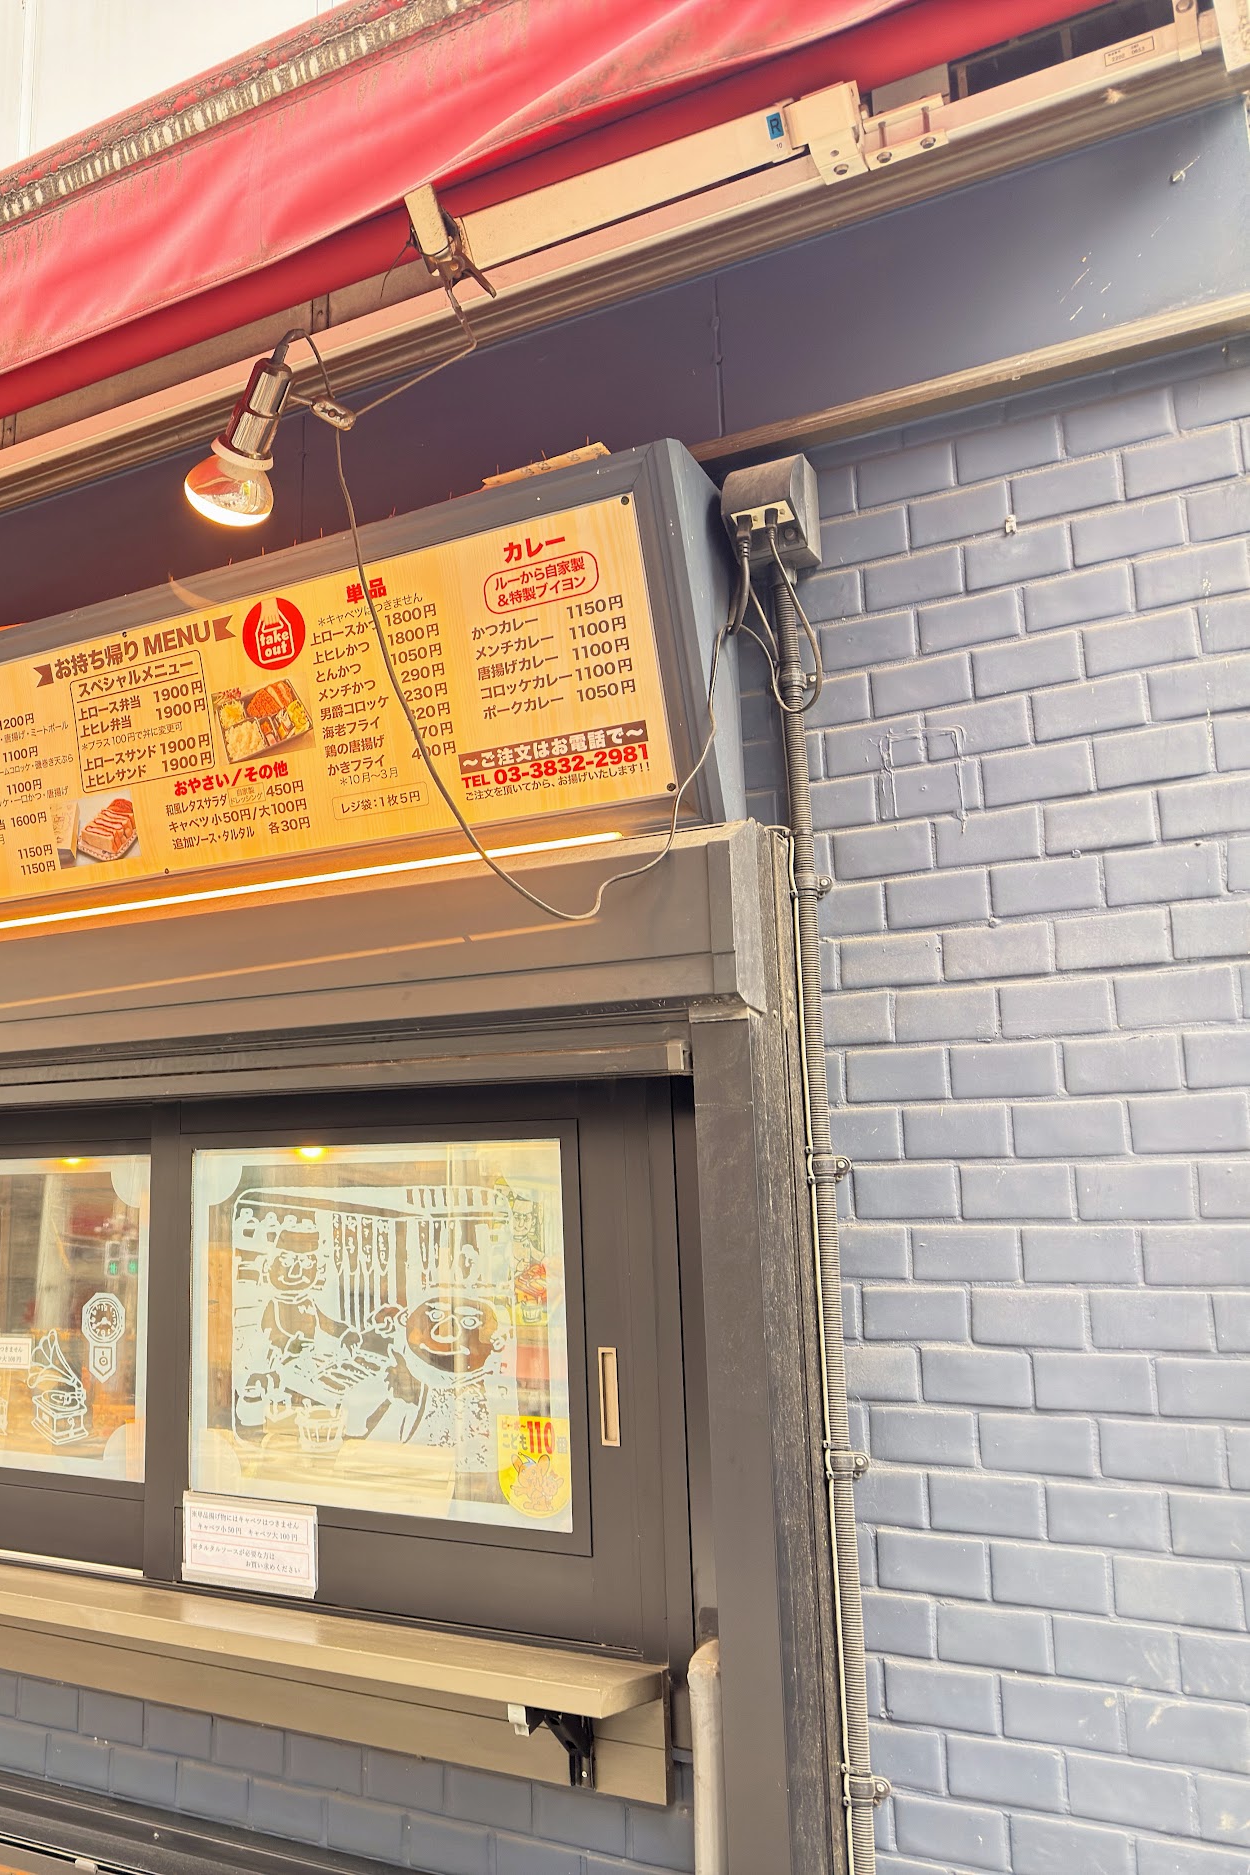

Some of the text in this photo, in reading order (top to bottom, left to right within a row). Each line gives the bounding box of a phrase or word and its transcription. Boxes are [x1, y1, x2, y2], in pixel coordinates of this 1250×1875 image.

[770, 118, 781, 135] R
[504, 536, 565, 564] カレー
[346, 577, 388, 604] 単品
[495, 556, 585, 591] ルーから自家製
[385, 603, 437, 627] 1800円
[471, 594, 623, 641] かつカレー 1150円
[54, 620, 211, 680] お持ち帰り MENU
[259, 629, 290, 648] take
[264, 642, 288, 658] out
[312, 623, 440, 665] 上ヒレかつ 1800円
[475, 615, 627, 661] メンチカレー 1100円
[315, 642, 442, 683] とんかつ 1050円
[478, 637, 630, 681] 唐揚げカレー 1100円
[78, 660, 194, 698] スペシャルメニュー
[318, 662, 445, 702] メンチかつ 290円
[480, 658, 633, 700] コロッケカレー 1100円
[78, 680, 204, 722] 上ロース弁当 1900円
[320, 682, 448, 721] 男爵コロッケ 230円
[483, 679, 636, 720] ポークカレー 1050円
[80, 698, 206, 739] 上ヒレ弁当 1900円
[322, 716, 381, 740] 海老フライ
[3, 745, 39, 763] 1100円
[84, 733, 211, 772] 上ロースサンド 1900円
[324, 721, 454, 759] 鶏の唐揚げ 70円
[86, 750, 213, 789] 上ヒレサンド 1900円
[328, 754, 385, 777] かきフライ
[461, 744, 649, 789] TEL 03-3832-2981
[6, 778, 42, 795] 1100円
[165, 780, 304, 817] 和風レタスサラダ 450円
[10, 811, 47, 828] 1600円
[169, 816, 209, 833] キャベツ
[268, 816, 311, 835] 各30円
[18, 844, 53, 860] 1150円
[21, 860, 56, 876] 1150円
